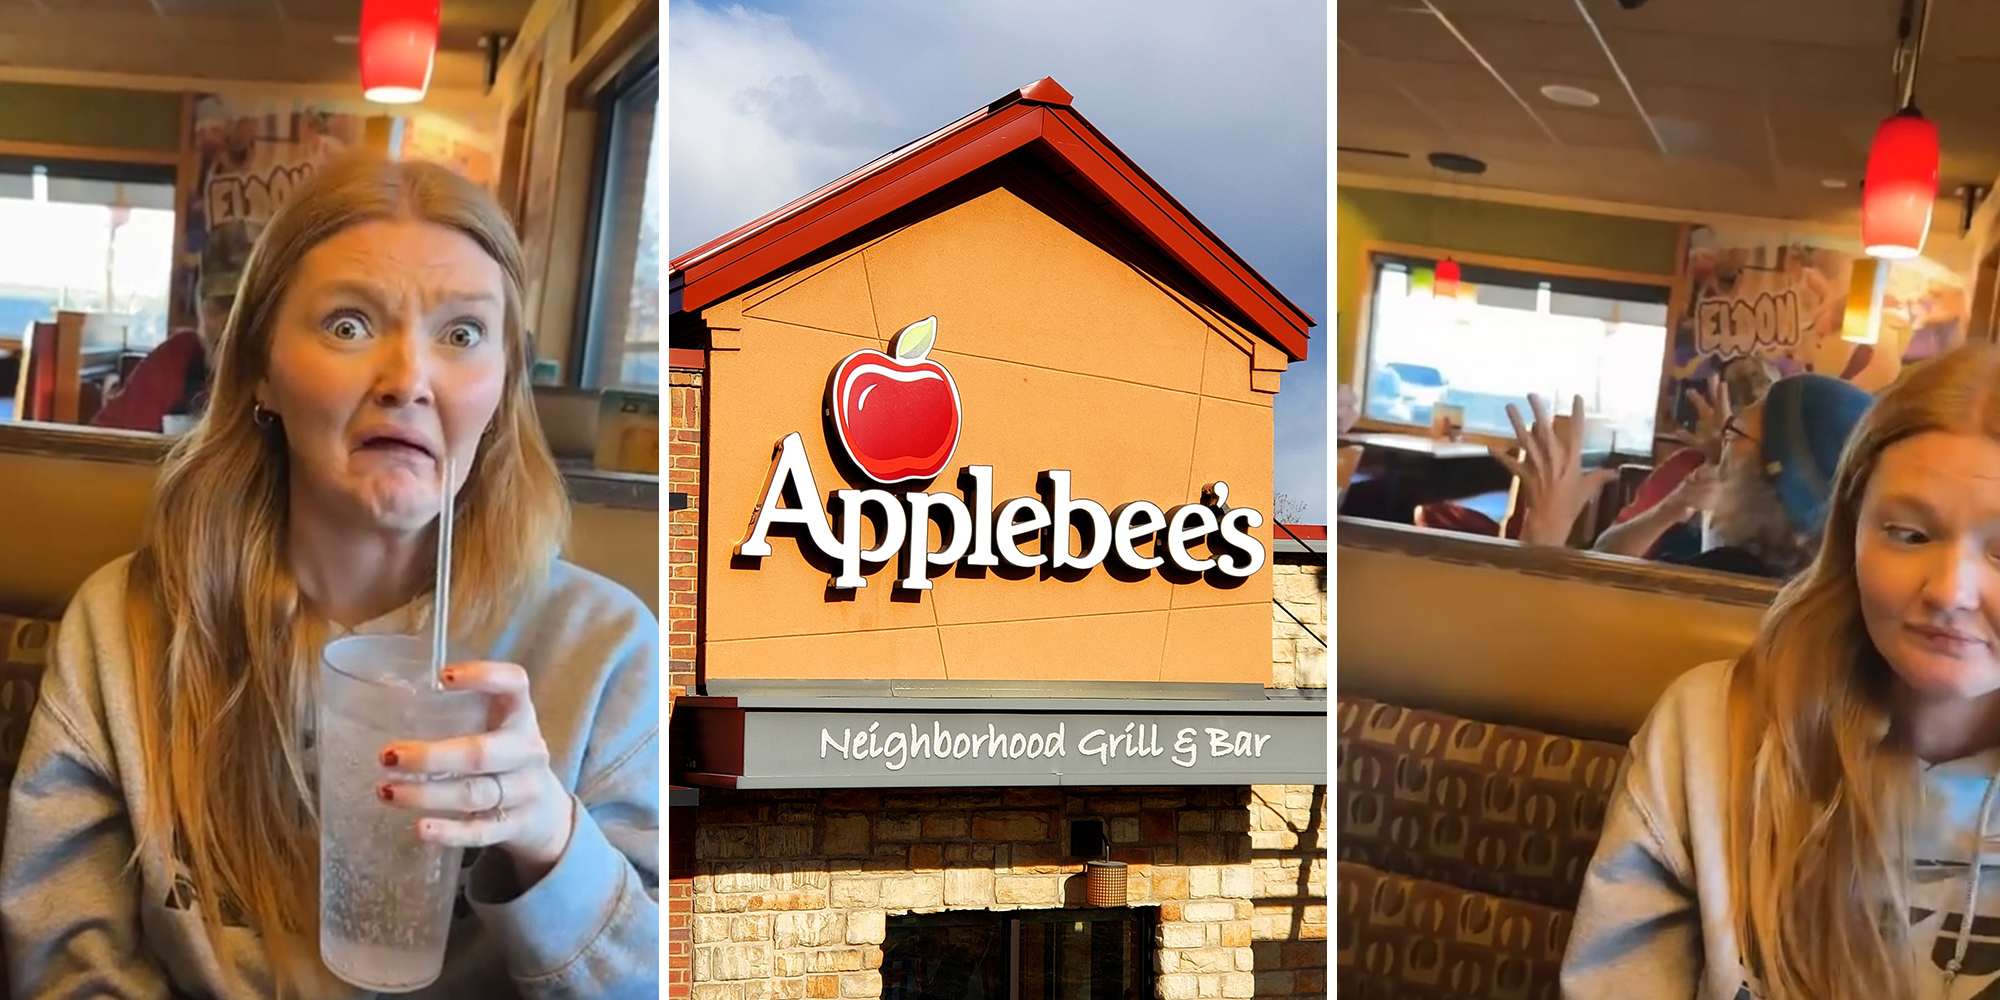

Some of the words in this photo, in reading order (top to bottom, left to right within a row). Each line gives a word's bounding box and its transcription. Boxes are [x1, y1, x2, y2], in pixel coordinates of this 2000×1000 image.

[1700, 289, 1798, 356] ELDON
[740, 430, 1266, 590] Applebee's
[820, 720, 1066, 770] Neighborhood
[1078, 721, 1164, 765] Grill
[1171, 727, 1197, 767] &
[1204, 727, 1271, 757] Bar
